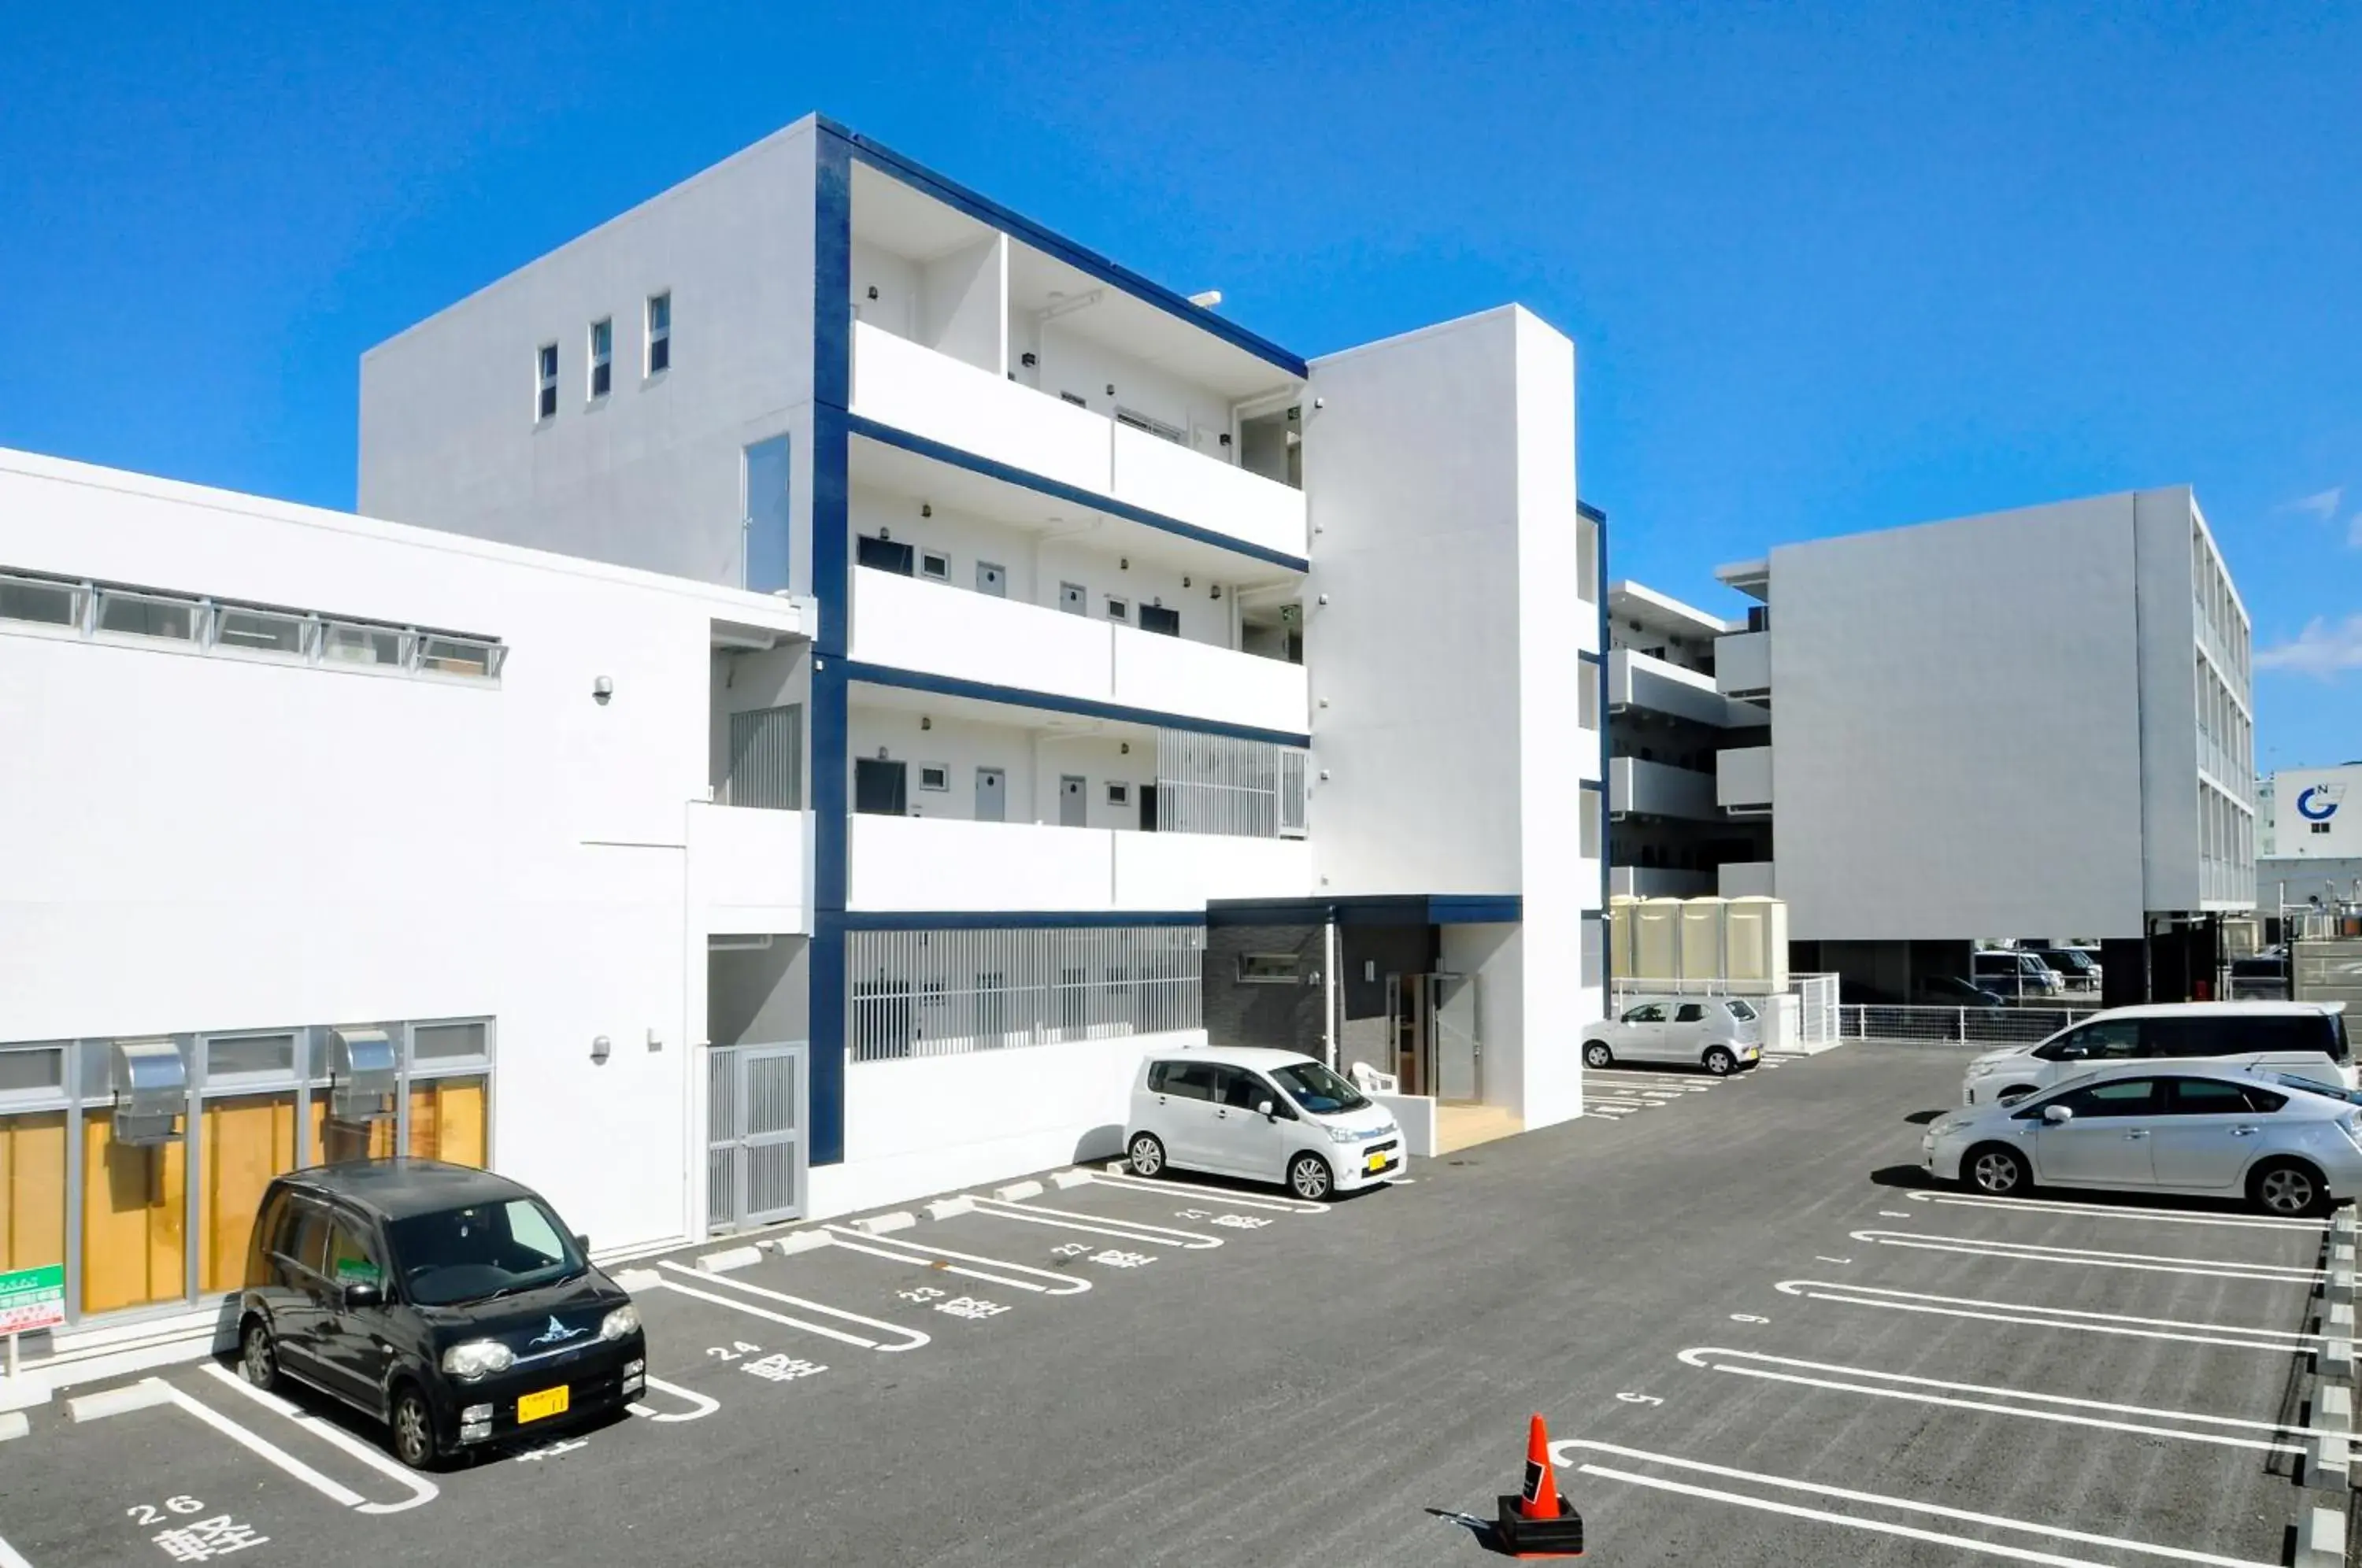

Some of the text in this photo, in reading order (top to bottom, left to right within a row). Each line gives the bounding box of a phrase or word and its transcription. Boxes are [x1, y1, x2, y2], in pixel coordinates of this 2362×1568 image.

[1050, 1243, 1094, 1256] 22
[706, 1341, 761, 1361] 24
[1615, 1392, 1664, 1407] 5
[126, 1495, 205, 1526] 26
[150, 1514, 272, 1562] 軽
